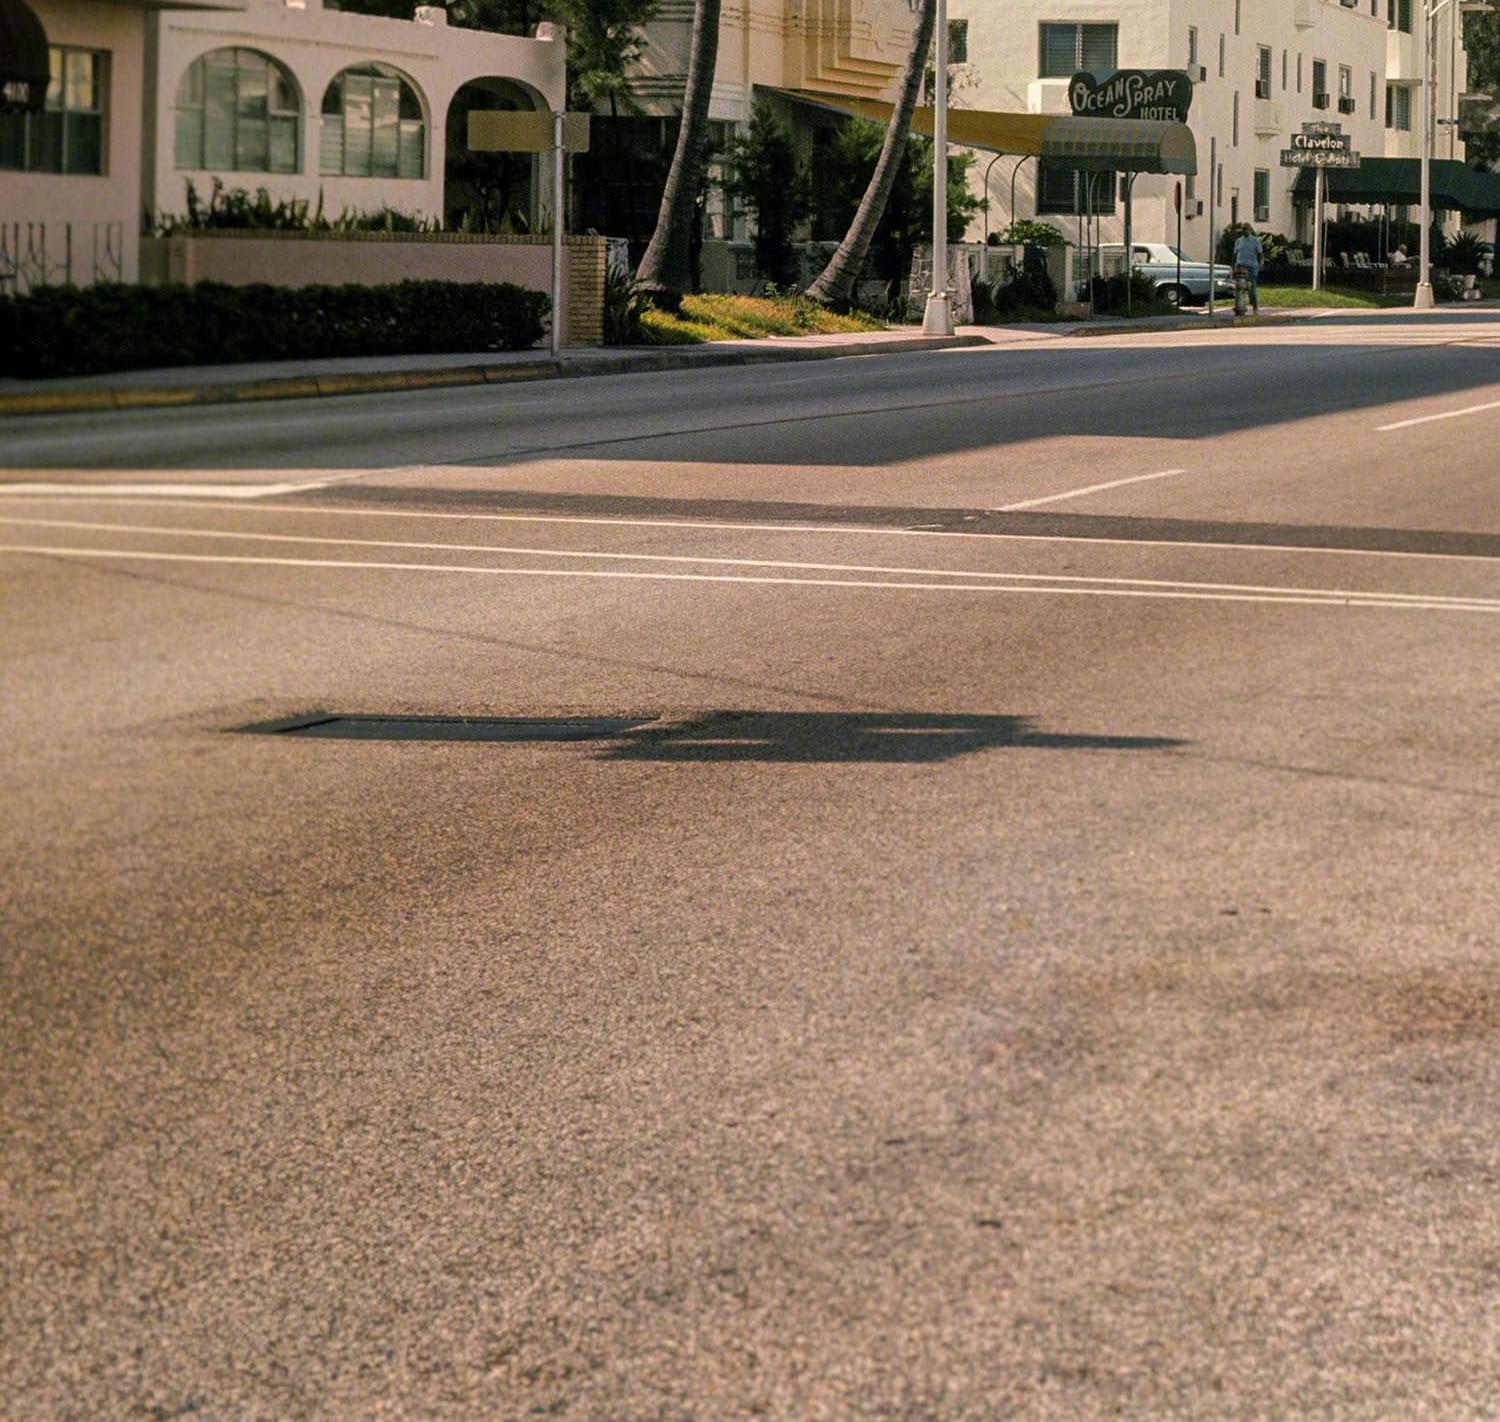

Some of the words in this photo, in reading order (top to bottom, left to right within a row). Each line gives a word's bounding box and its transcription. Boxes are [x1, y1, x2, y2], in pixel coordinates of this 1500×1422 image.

[1072, 78, 1125, 111] OCEAN
[1113, 75, 1177, 118] SPRAY
[1140, 106, 1180, 122] HOTEL
